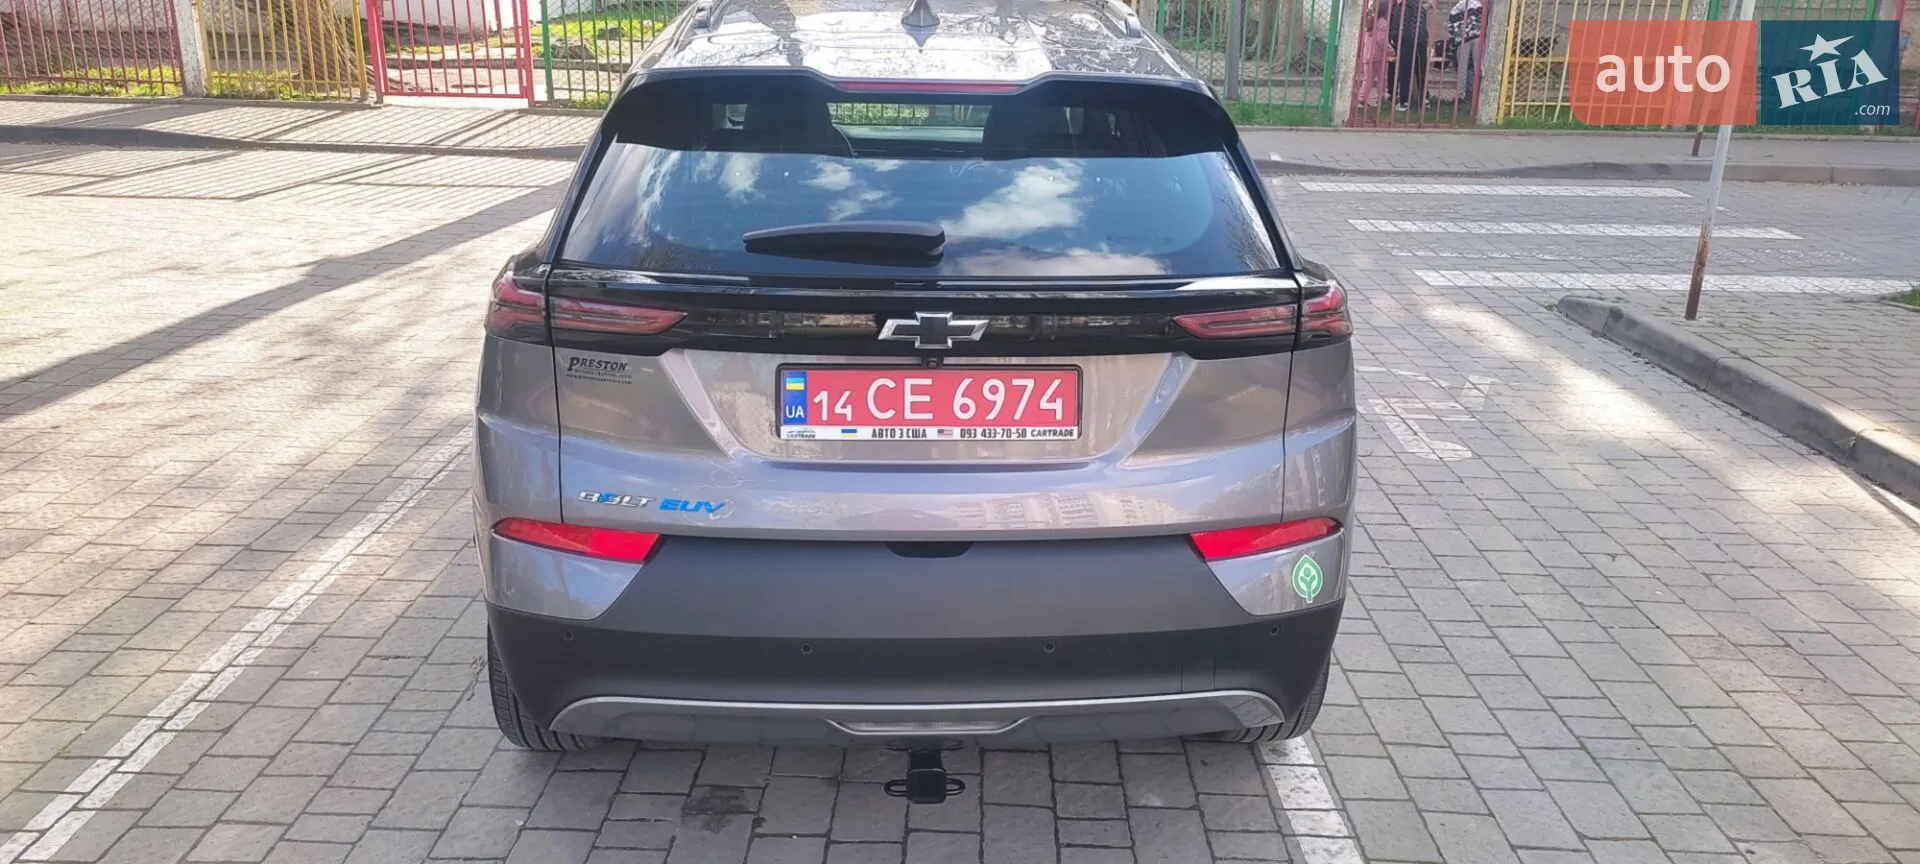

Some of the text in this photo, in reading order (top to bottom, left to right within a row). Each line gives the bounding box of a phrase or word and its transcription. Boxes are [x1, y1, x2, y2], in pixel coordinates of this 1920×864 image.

[567, 357, 628, 371] PRESTON
[812, 377, 1063, 421] 14 CE 6974
[785, 405, 805, 419] UA
[871, 428, 896, 439] АВТО
[906, 428, 928, 439] США
[960, 428, 1027, 439] 093 433-70-50
[1030, 428, 1075, 438] CARTRADE
[579, 490, 726, 514] BOLT EUV
